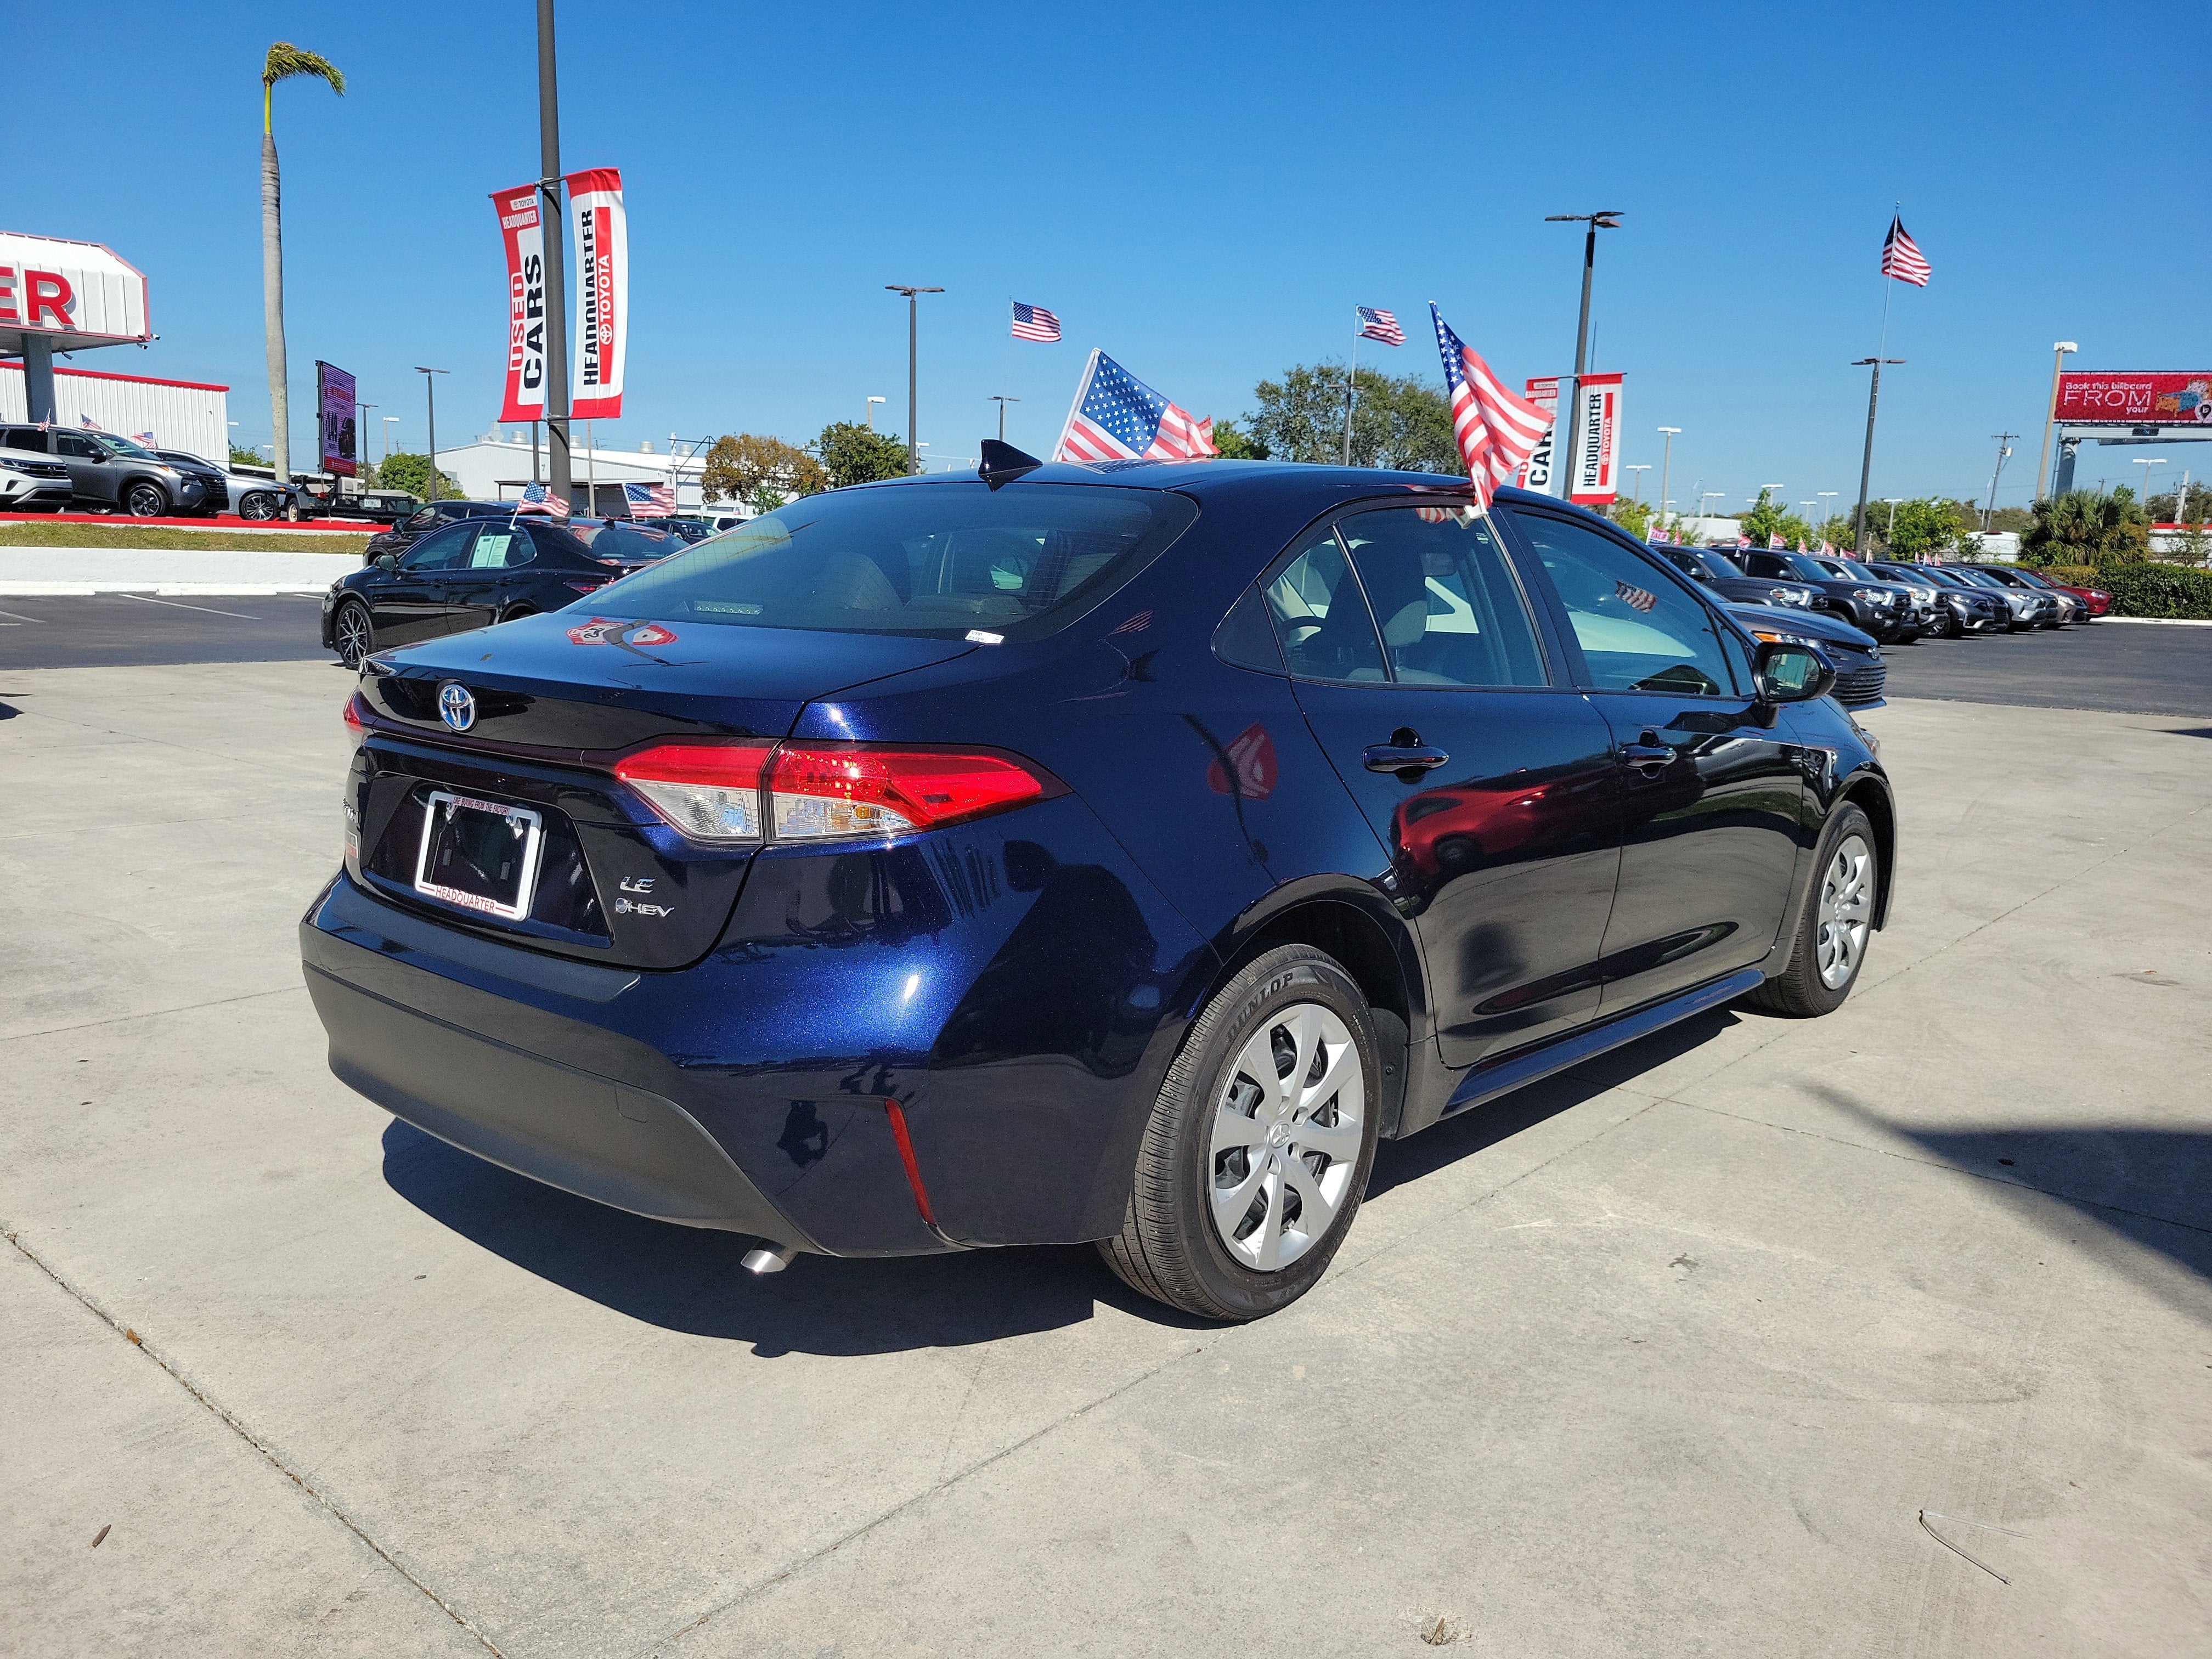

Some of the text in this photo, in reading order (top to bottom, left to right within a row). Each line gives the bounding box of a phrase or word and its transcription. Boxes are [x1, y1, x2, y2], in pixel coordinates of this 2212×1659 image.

[518, 198, 534, 208] TOYOTA
[501, 210, 537, 229] HEADQUARTER
[598, 254, 611, 323] TOYOTA
[510, 272, 524, 371] USED
[524, 254, 543, 389] CARS
[2063, 390, 2152, 407] FROM
[2066, 382, 2152, 390] Book this billboard
[2126, 407, 2148, 415] your
[1583, 393, 1601, 487] HEADQUARTER
[1602, 417, 1612, 454] TOYOTA
[1530, 420, 1555, 486] CAR
[620, 876, 656, 893] LE
[436, 886, 495, 912] HEADQUARTER
